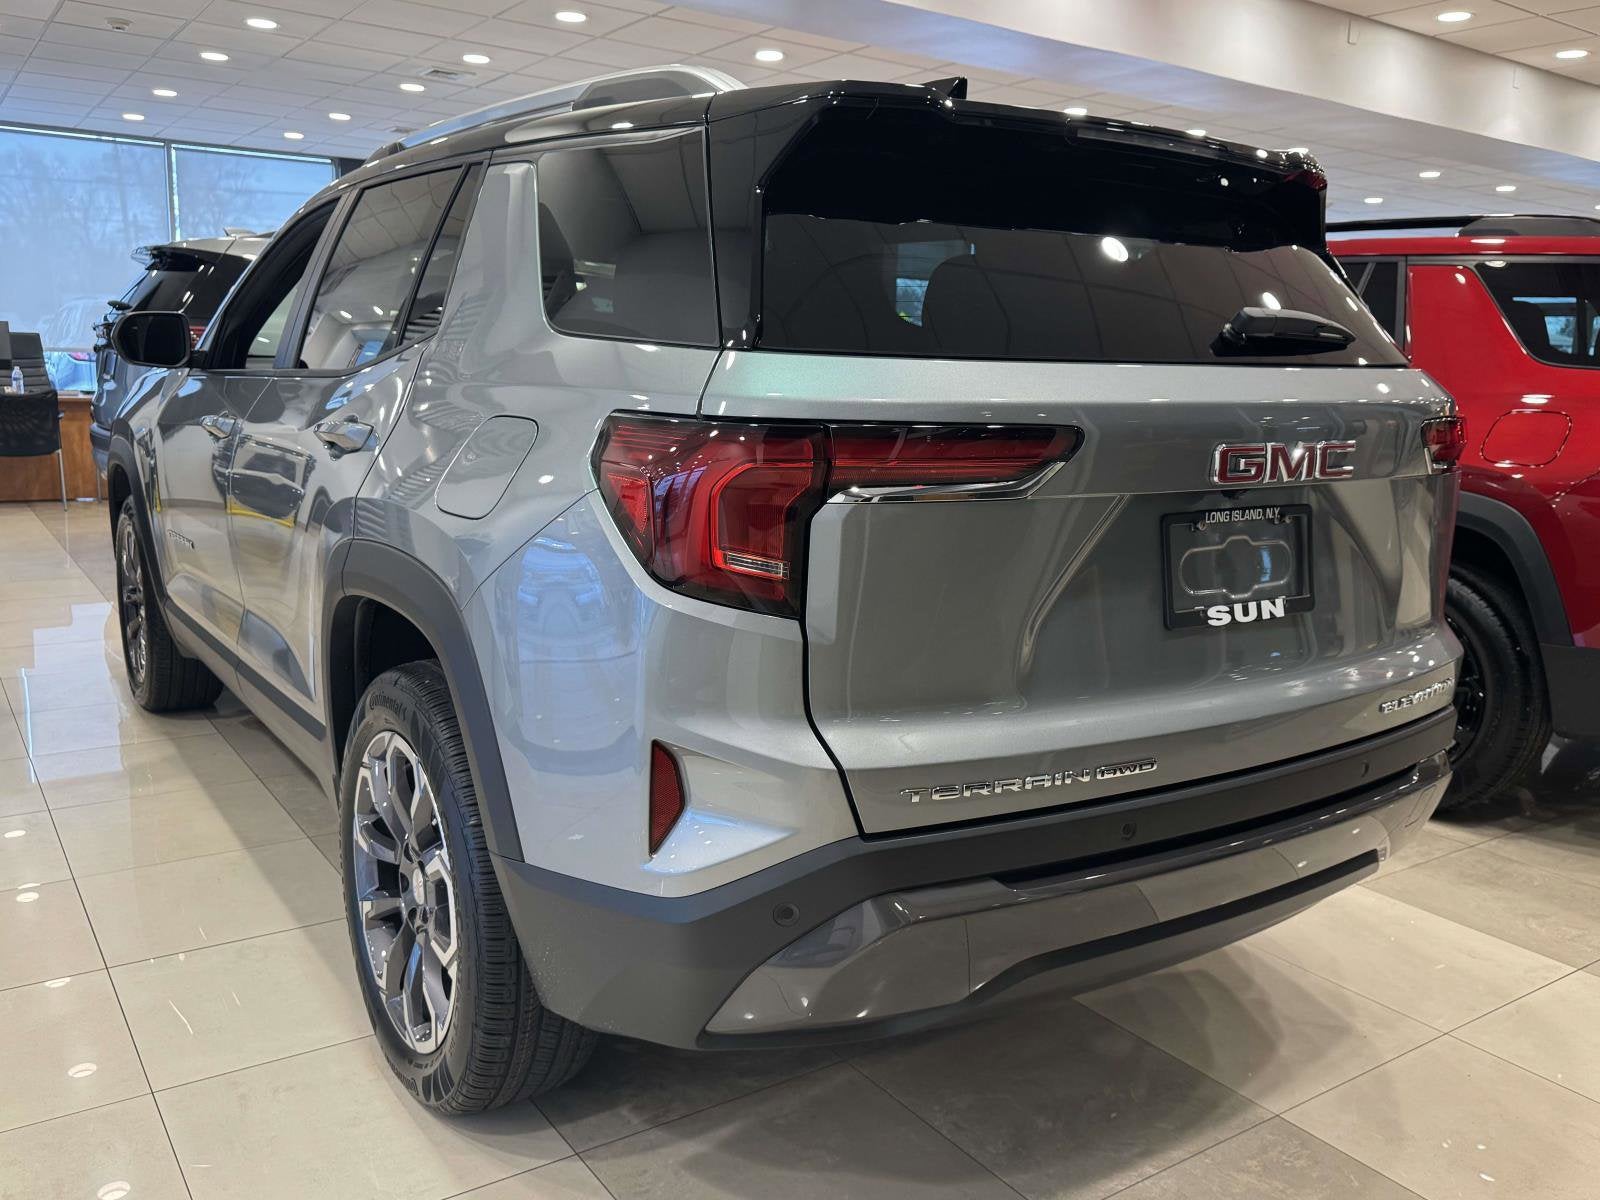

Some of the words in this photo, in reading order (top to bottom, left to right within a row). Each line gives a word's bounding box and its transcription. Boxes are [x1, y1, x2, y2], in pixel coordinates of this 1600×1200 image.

[1214, 440, 1356, 484] GMC
[1205, 511, 1230, 523] LONG
[1231, 508, 1264, 522] ISLAND,
[1207, 598, 1285, 626] SUN
[1379, 678, 1455, 714] ELEVATION
[900, 768, 1091, 803] TERRAIN
[1097, 759, 1158, 780] AWD
